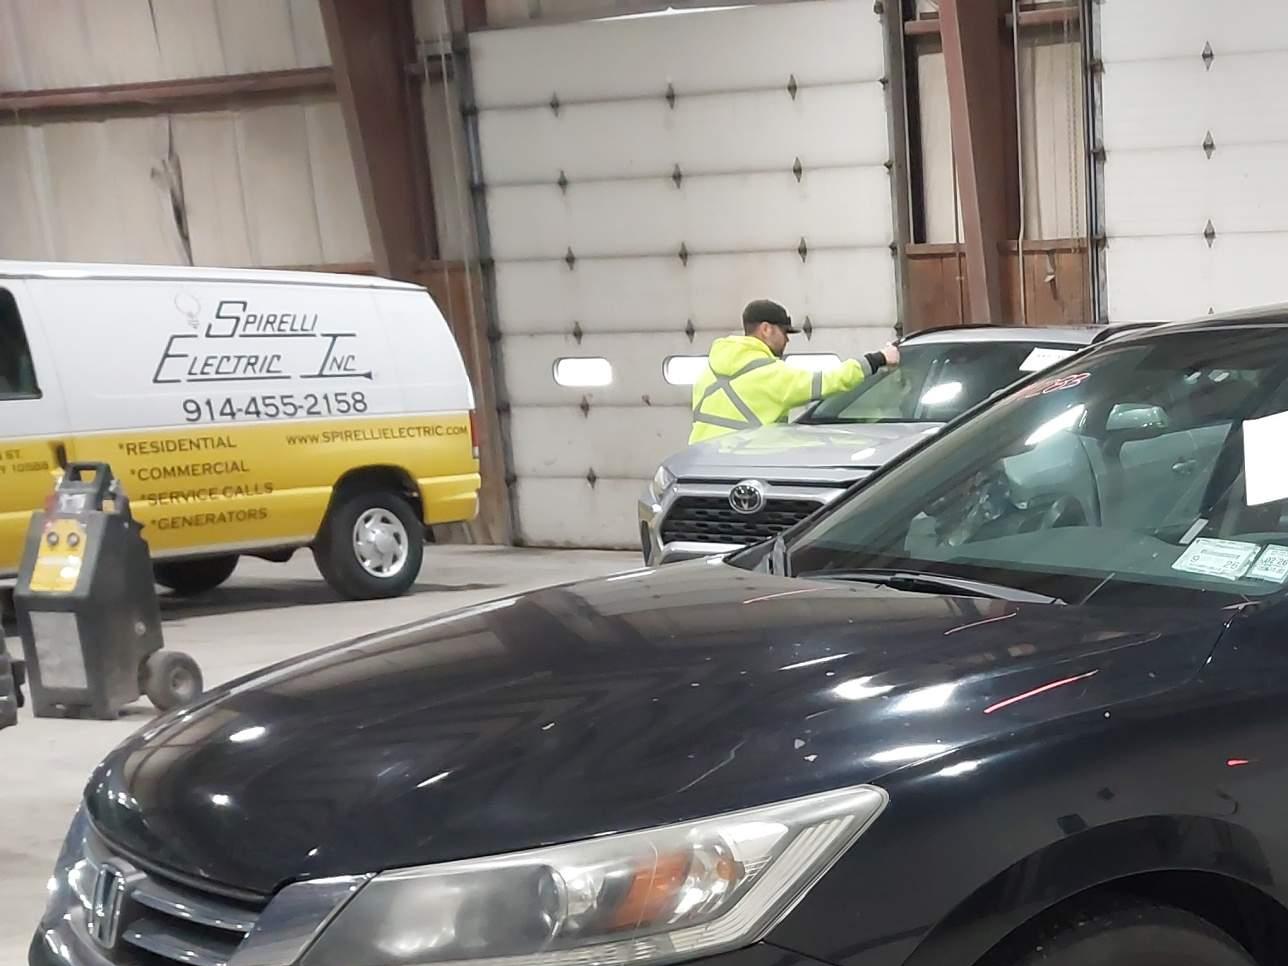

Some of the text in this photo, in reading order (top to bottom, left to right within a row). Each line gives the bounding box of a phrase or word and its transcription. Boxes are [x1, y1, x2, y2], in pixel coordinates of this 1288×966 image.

[205, 301, 318, 338] SPIRELLI
[153, 335, 282, 383] ELECTRIC
[182, 391, 369, 422] 914-455-2158
[222, 482, 273, 499] CALLS
